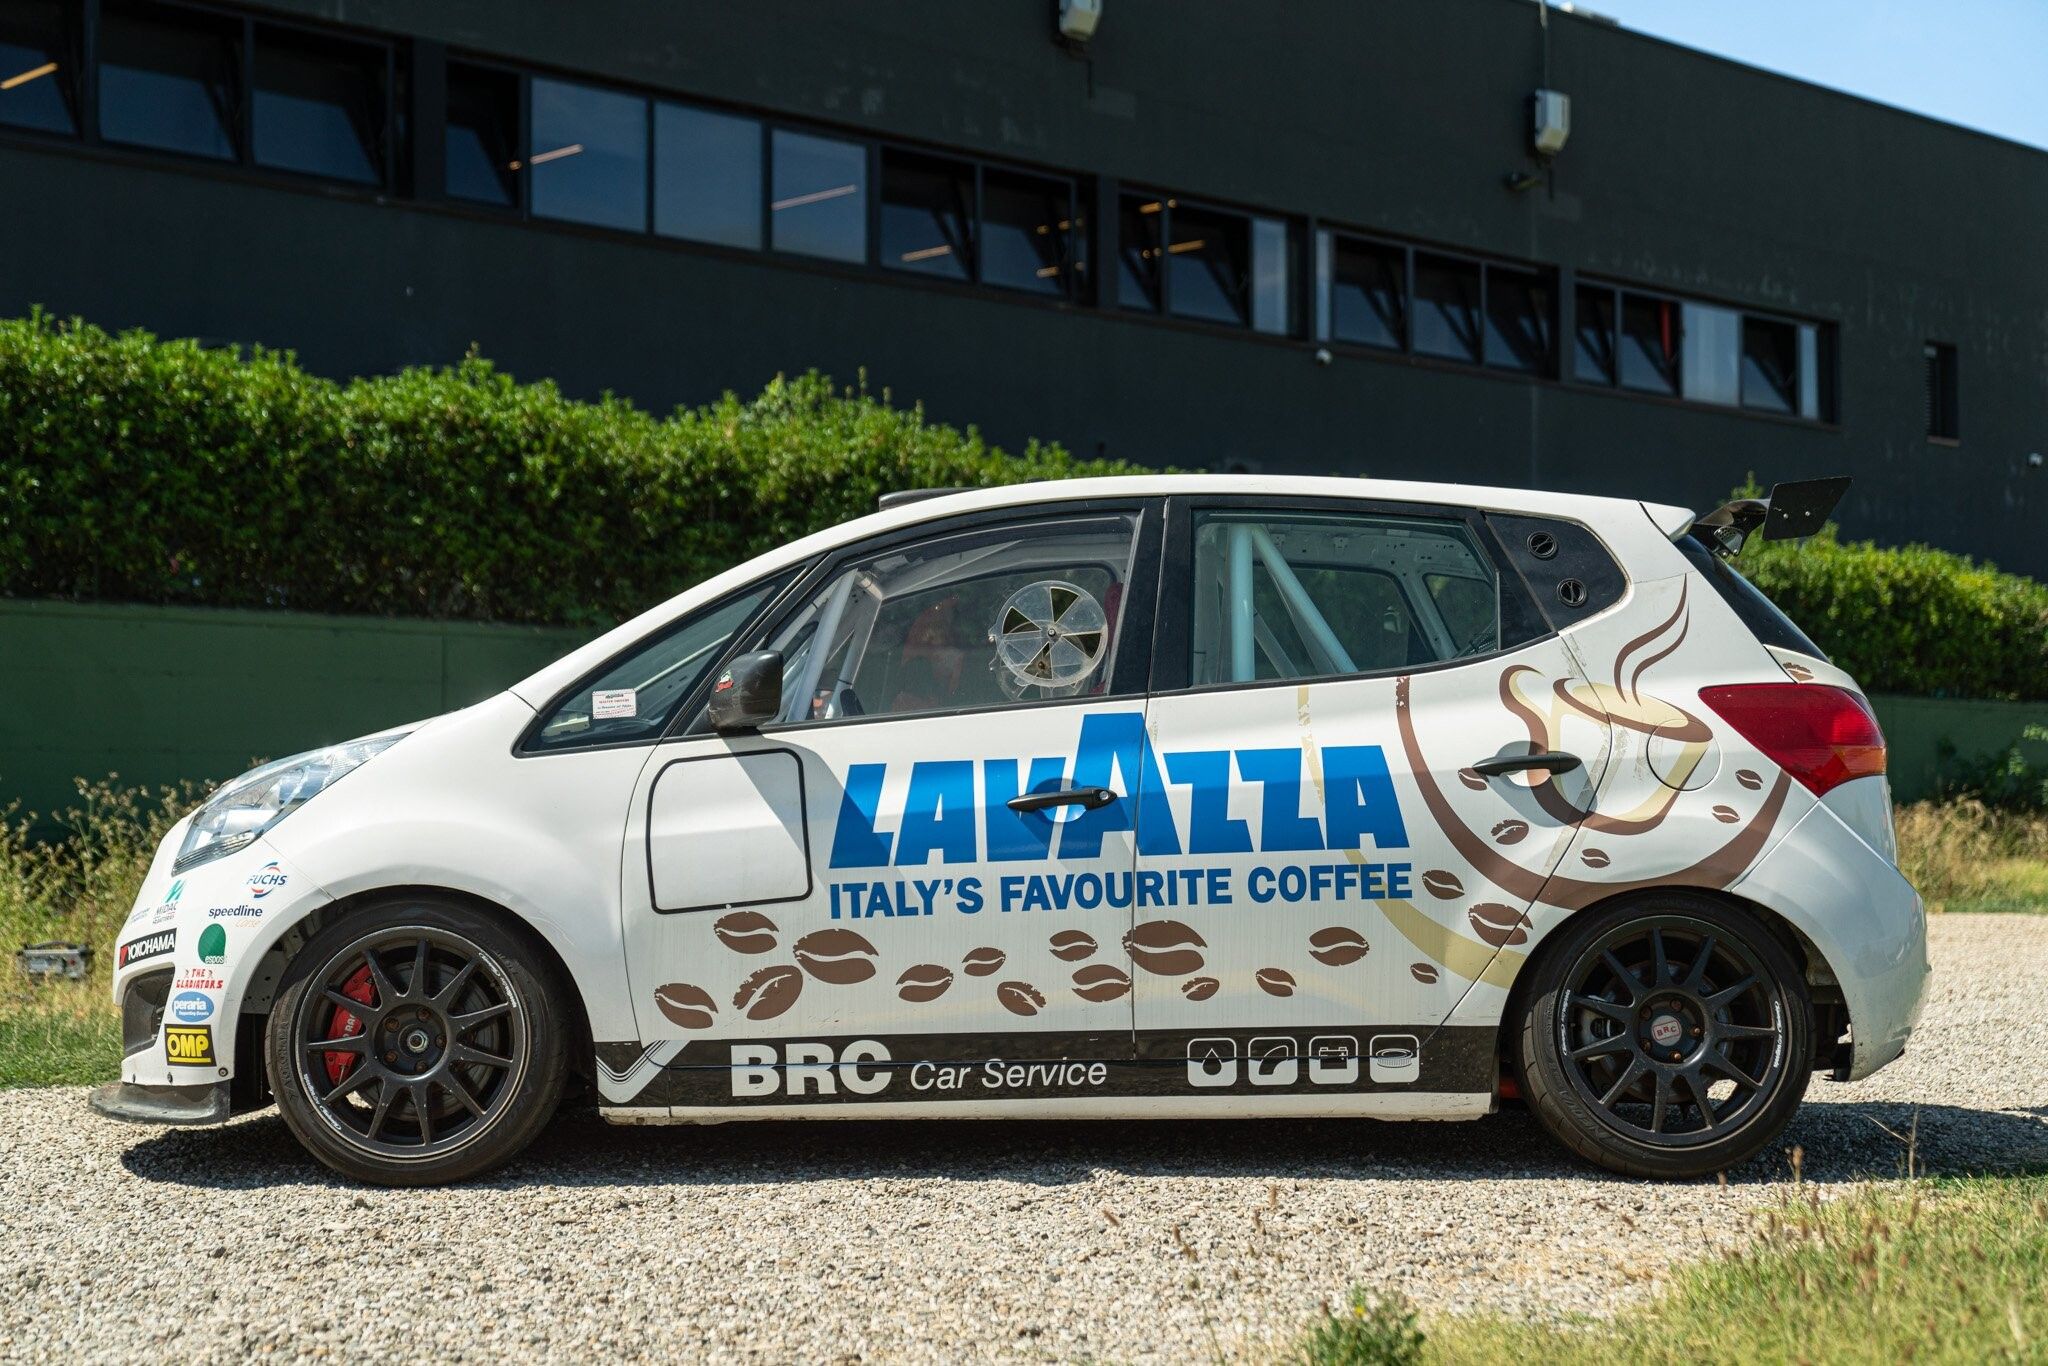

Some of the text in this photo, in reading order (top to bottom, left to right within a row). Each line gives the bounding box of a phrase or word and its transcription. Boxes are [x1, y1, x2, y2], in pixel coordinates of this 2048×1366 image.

[829, 713, 1410, 869] LAVAZZA
[246, 874, 288, 886] FUCHS
[830, 863, 1413, 920] ITALY'S FAVOURITE COFFEE
[208, 905, 263, 920] speedline
[127, 933, 175, 961] YOKOHAMA
[191, 968, 206, 978] THE
[175, 979, 224, 989] GLADIATORS
[1656, 1026, 1677, 1036] BRC
[167, 1033, 209, 1057] OMP
[731, 1040, 1108, 1098] BRC Car Service
